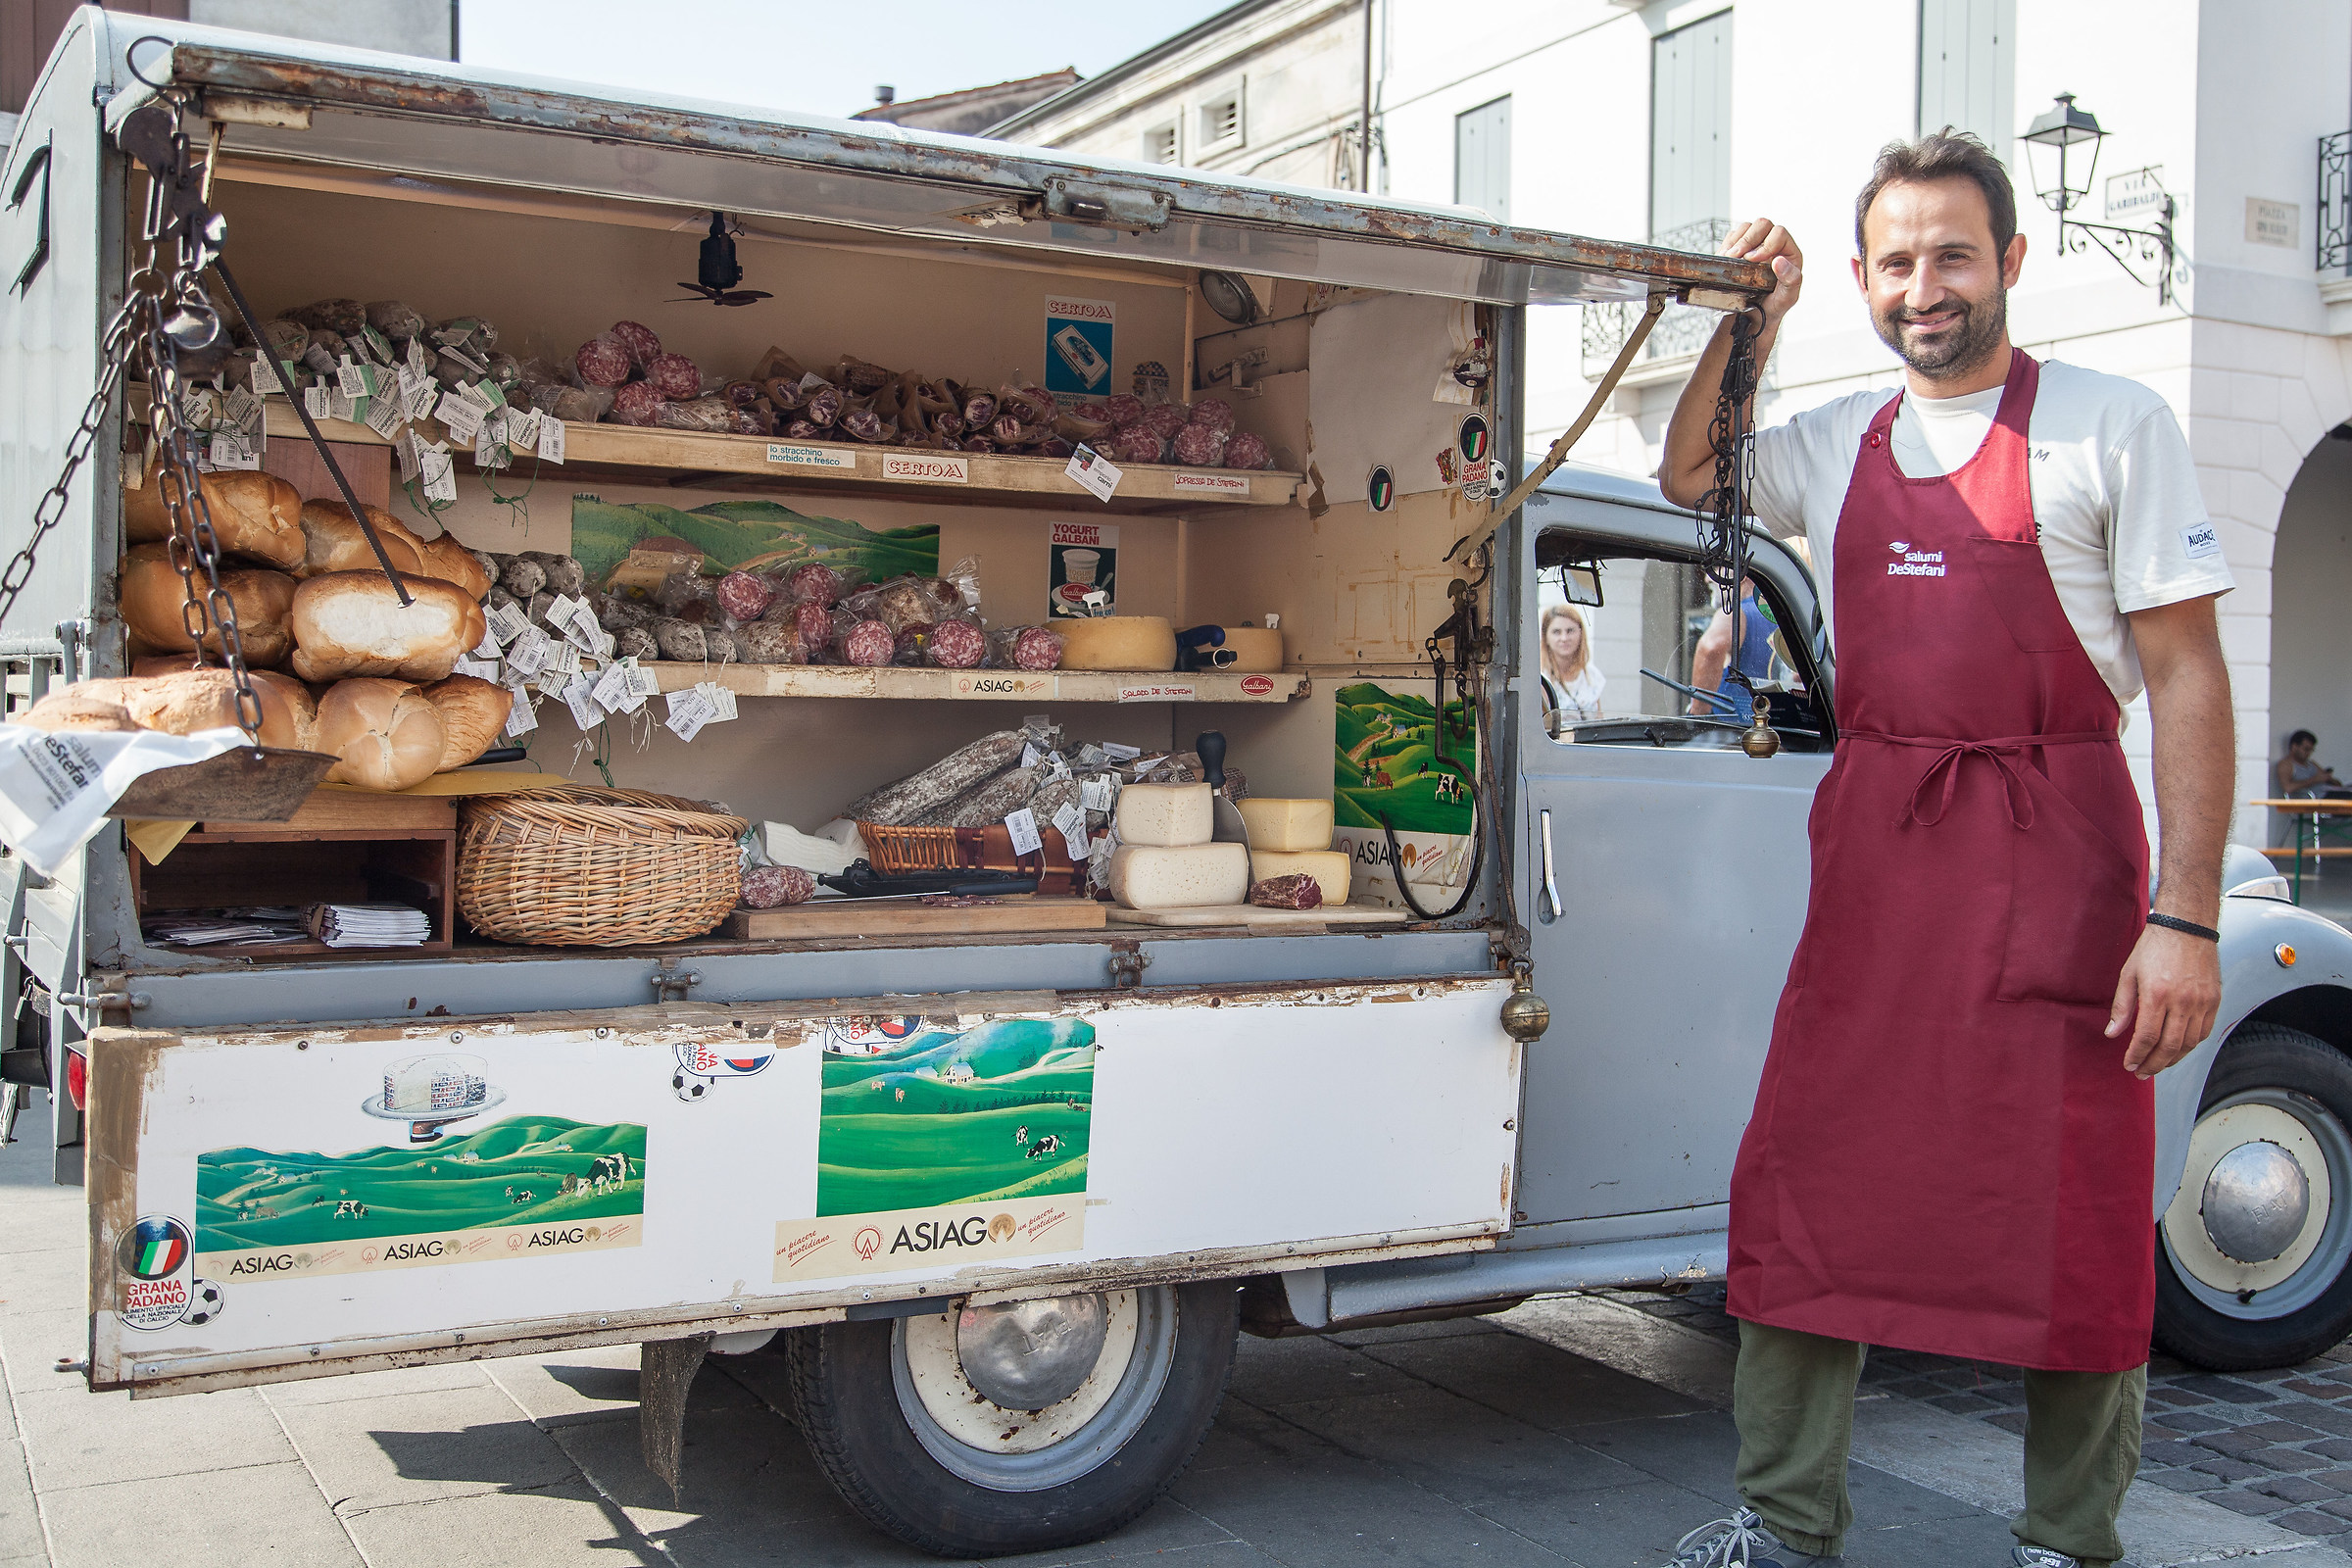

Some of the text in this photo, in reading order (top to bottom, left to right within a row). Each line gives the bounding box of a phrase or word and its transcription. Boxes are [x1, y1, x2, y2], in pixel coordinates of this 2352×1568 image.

[412, 389, 428, 414] DeStefani
[378, 409, 398, 432] DeStefani
[518, 419, 534, 443] DeStefani
[781, 446, 823, 456] stracchino
[770, 454, 804, 463] morbido
[814, 456, 840, 466] fresco
[1464, 462, 1486, 473] GRANA
[1462, 470, 1488, 483] PADANO
[1054, 523, 1100, 536] YOGURT
[1053, 534, 1100, 545] GALBANI
[1904, 551, 1942, 563] salumi
[1887, 563, 1945, 577] DeStefani
[1242, 677, 1272, 692] Galbani
[2252, 1185, 2287, 1225] FIAT
[1018, 1206, 1054, 1232] un piacere
[1028, 1211, 1066, 1237] quotidiano
[776, 1230, 817, 1256] un piacere
[787, 1234, 830, 1261] quotidiano
[128, 1279, 183, 1296] GRANA
[147, 1309, 182, 1318] NAZIONALE
[155, 1303, 186, 1312] UFFICIALE
[2039, 1556, 2061, 1568] 991
